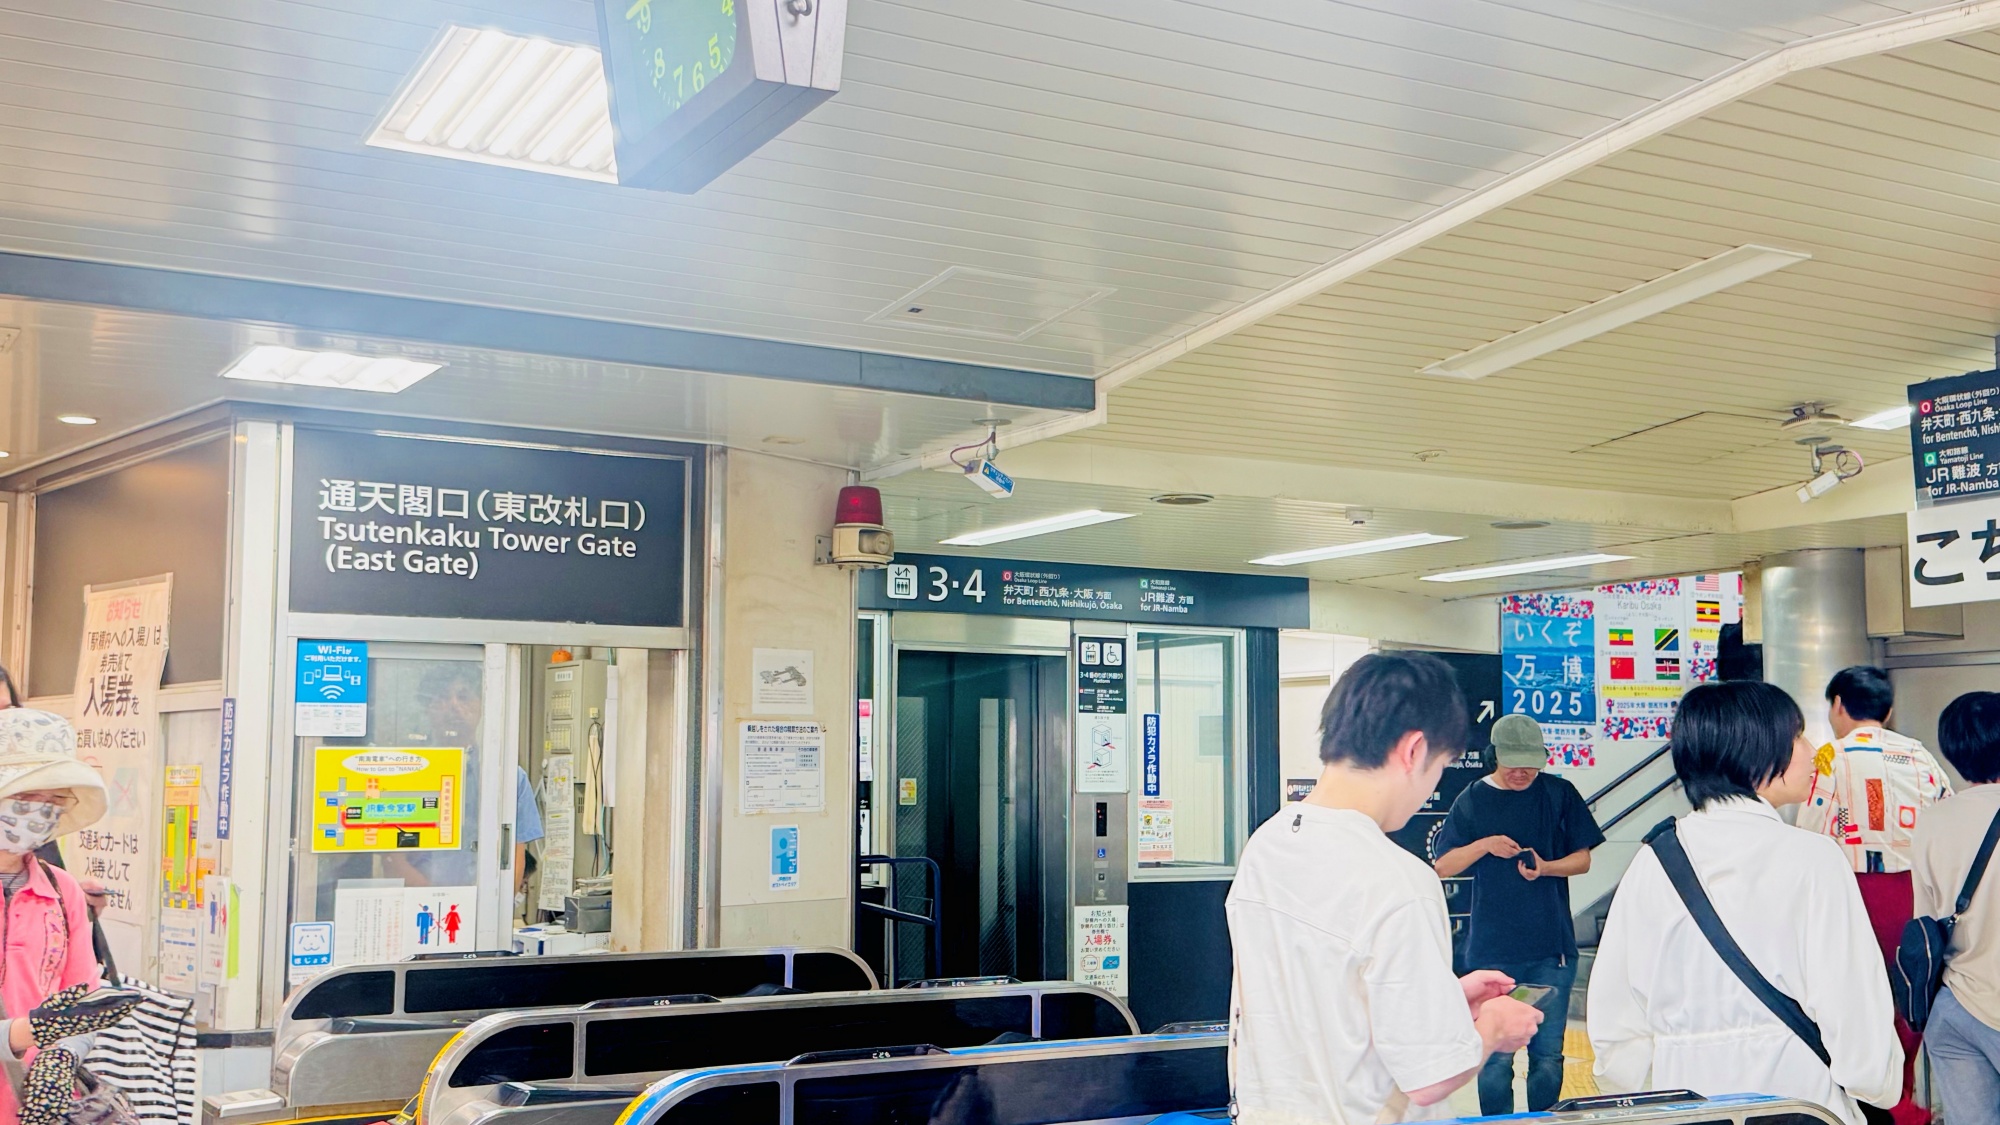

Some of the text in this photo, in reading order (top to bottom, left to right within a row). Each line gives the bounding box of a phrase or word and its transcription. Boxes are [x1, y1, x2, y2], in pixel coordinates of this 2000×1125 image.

[654, 48, 665, 78] 8
[708, 33, 720, 69] 5
[673, 65, 683, 98] 7
[693, 61, 704, 92] 6
[1956, 401, 1973, 409] Loop
[1973, 398, 1988, 406] Line
[1921, 406, 2000, 432] 弁天町・西九条・
[1922, 433, 1934, 445] for
[1940, 453, 1984, 465] Yamatoji Line
[1986, 462, 2000, 476] 方
[1945, 478, 1999, 495] JR-Namba
[318, 516, 637, 559] Tsutenkaku Tower Gate
[326, 544, 479, 580] (East Gate)
[106, 598, 141, 621] お知らせ
[1003, 596, 1015, 605] for
[1100, 600, 1123, 610] Ōsaka
[1140, 602, 1188, 613] for JR-Namba
[1617, 600, 1662, 610] Karibu Osaka
[1514, 620, 1582, 647] いくぞ
[1515, 654, 1584, 685] 万博
[1513, 689, 1582, 716] 2025
[77, 728, 146, 749] お買い求めください
[1146, 716, 1158, 793] 防犯カメラ作動中
[220, 702, 233, 834] 防犯カメラ作動中
